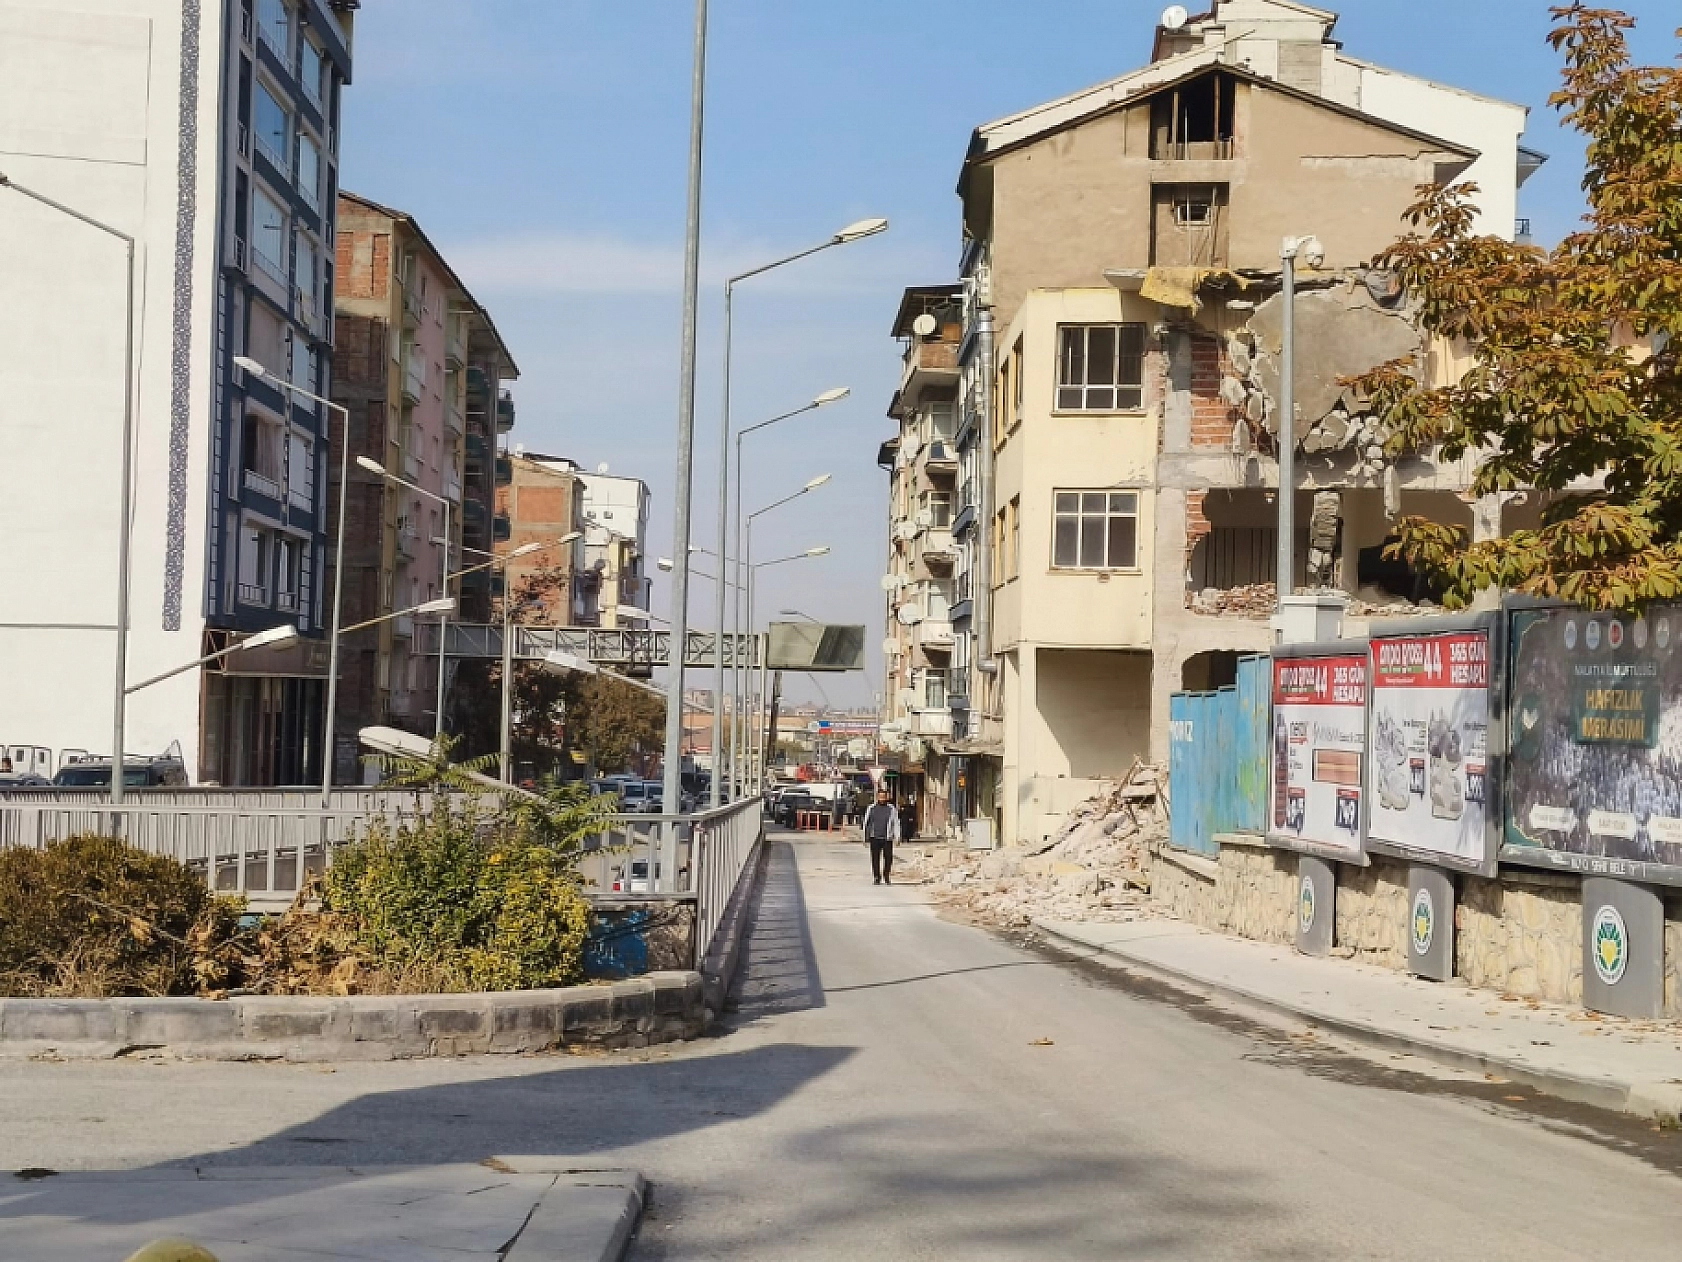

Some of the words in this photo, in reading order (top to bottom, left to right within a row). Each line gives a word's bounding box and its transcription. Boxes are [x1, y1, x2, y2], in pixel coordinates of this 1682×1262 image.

[1424, 641, 1442, 680] 44
[1449, 643, 1467, 663] 365
[1468, 636, 1486, 662] GÜN
[1315, 666, 1328, 699] 44
[1333, 666, 1348, 684] 365
[1450, 663, 1486, 684] HESAPLI
[1333, 685, 1365, 702] HESAPLI
[1585, 689, 1644, 711] HAFIZLIK
[1582, 713, 1645, 740] MERASİMİ
